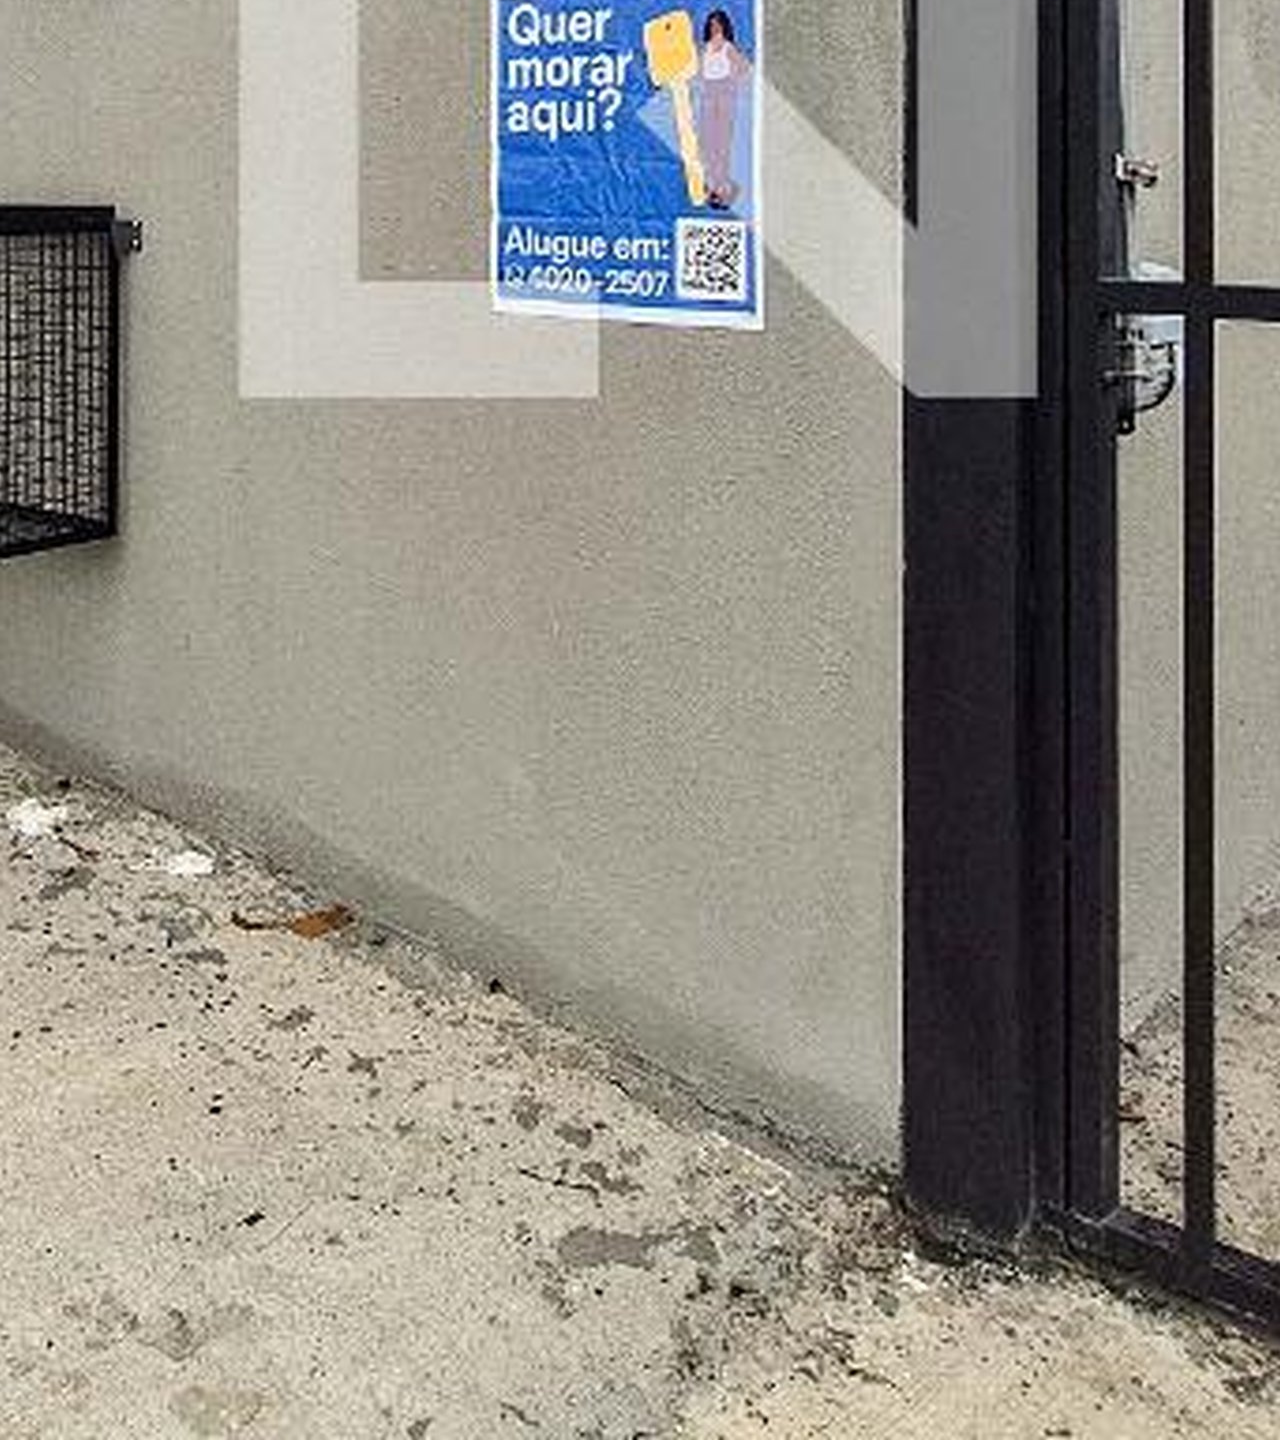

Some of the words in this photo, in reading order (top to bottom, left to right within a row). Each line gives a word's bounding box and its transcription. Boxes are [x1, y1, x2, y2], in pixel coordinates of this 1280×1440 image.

[507, 4, 612, 44] Quer
[507, 51, 632, 89] morar
[507, 89, 622, 143] aqui?
[505, 225, 607, 263] Alugue
[614, 237, 670, 260] em:
